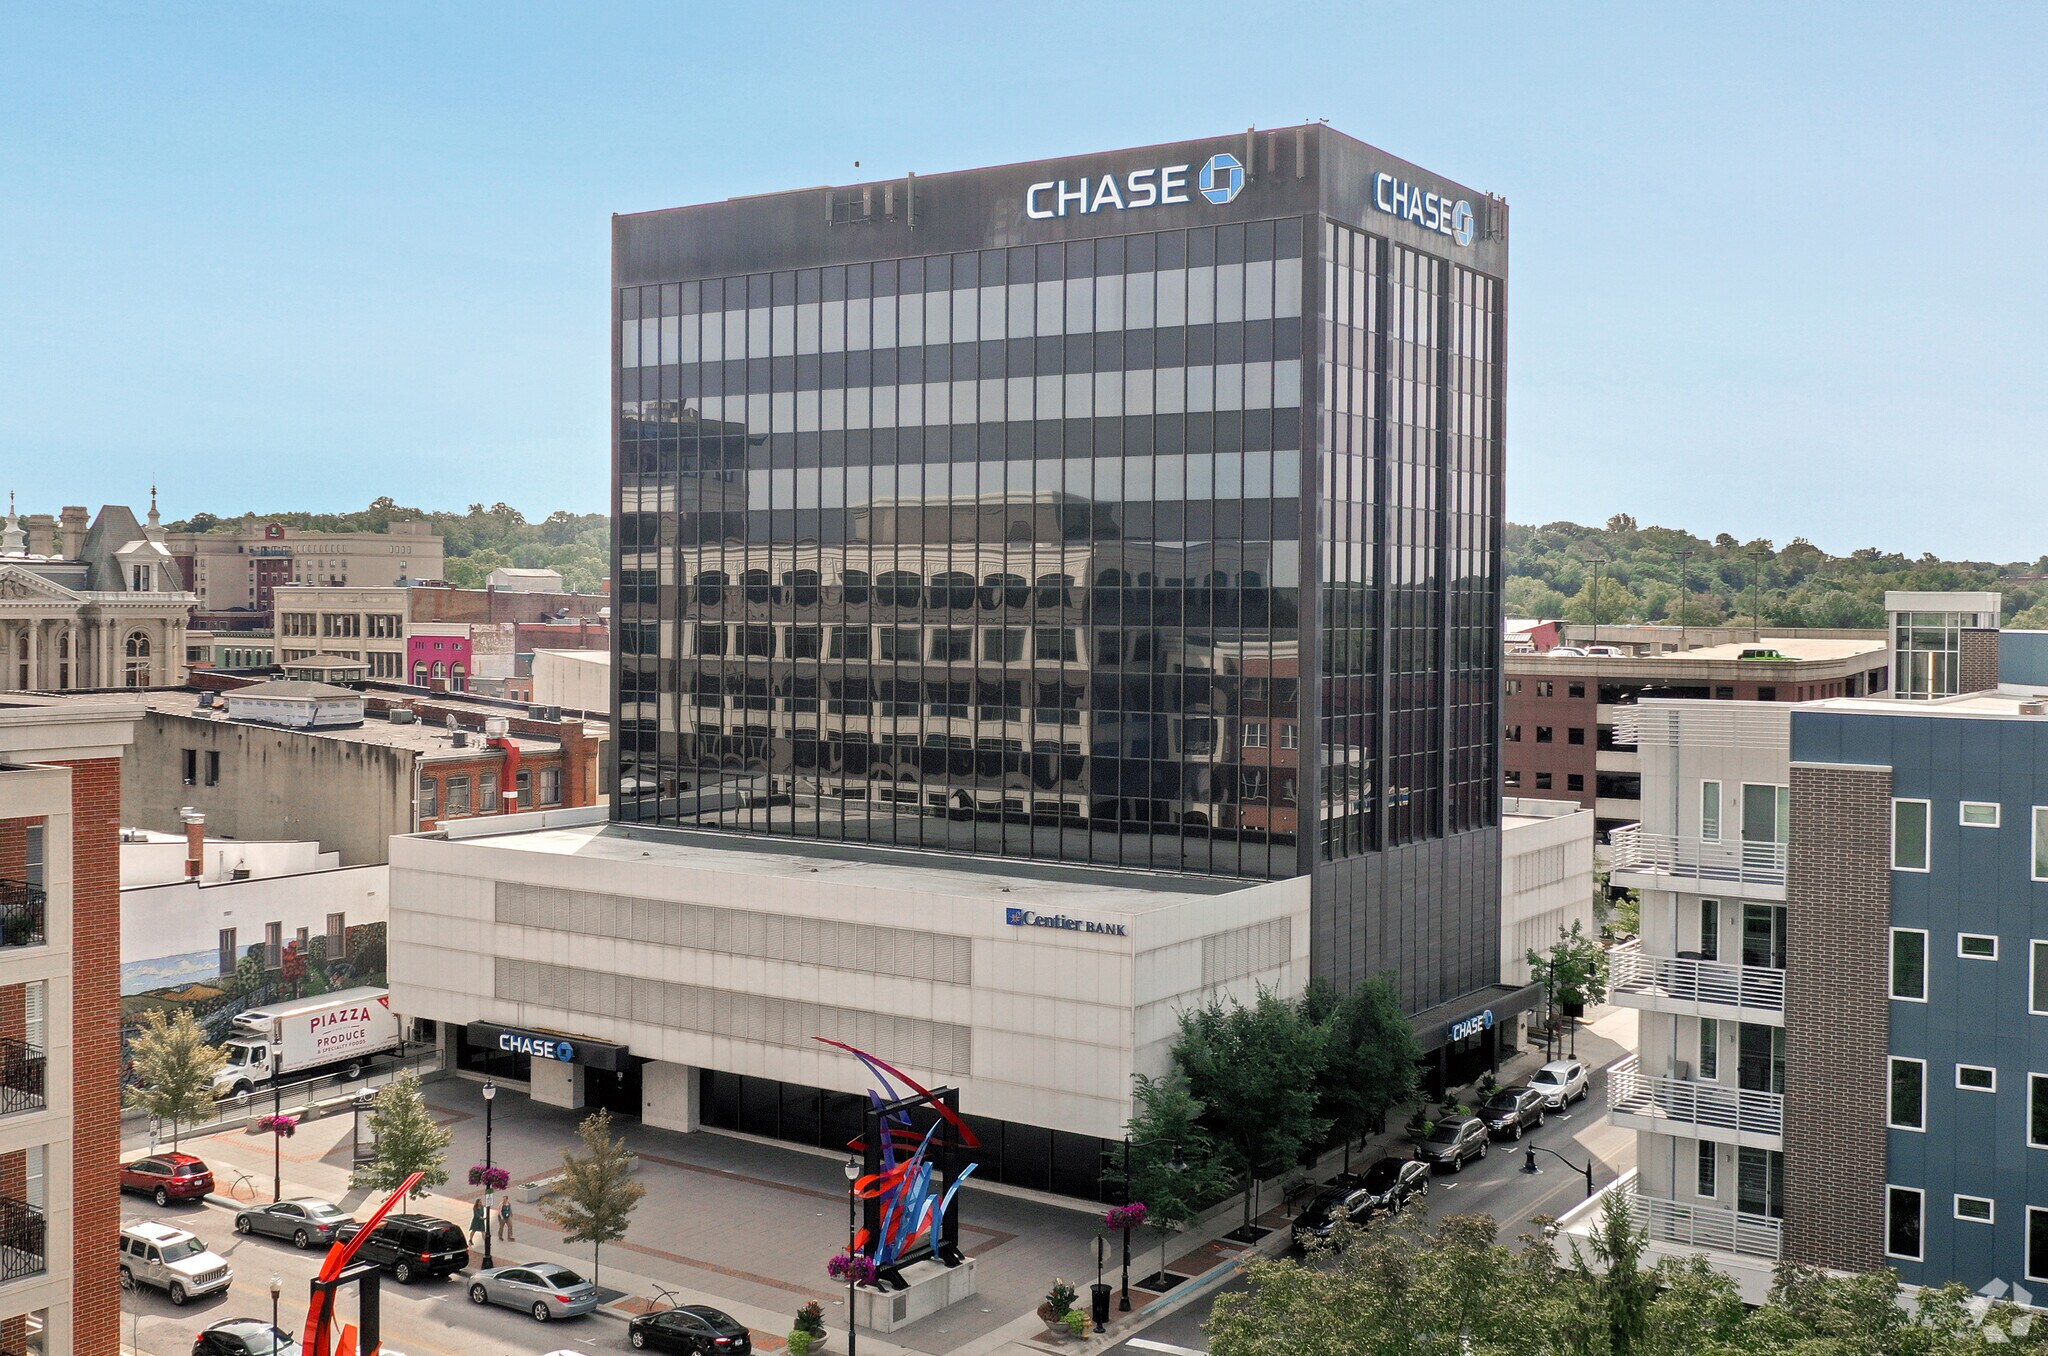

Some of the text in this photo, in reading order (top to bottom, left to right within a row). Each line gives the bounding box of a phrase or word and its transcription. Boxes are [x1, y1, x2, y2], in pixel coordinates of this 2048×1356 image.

[1026, 164, 1191, 219] CHASE
[1374, 171, 1453, 236] CHASE
[1023, 910, 1127, 936] Centier BANK
[310, 1007, 371, 1034] PIAZZA
[1452, 1015, 1484, 1041] CHASE
[317, 1029, 365, 1047] PRODUCE
[322, 1043, 348, 1053] SPECIALTY
[349, 1039, 367, 1047] FOODS
[500, 1034, 555, 1059] CHASE
